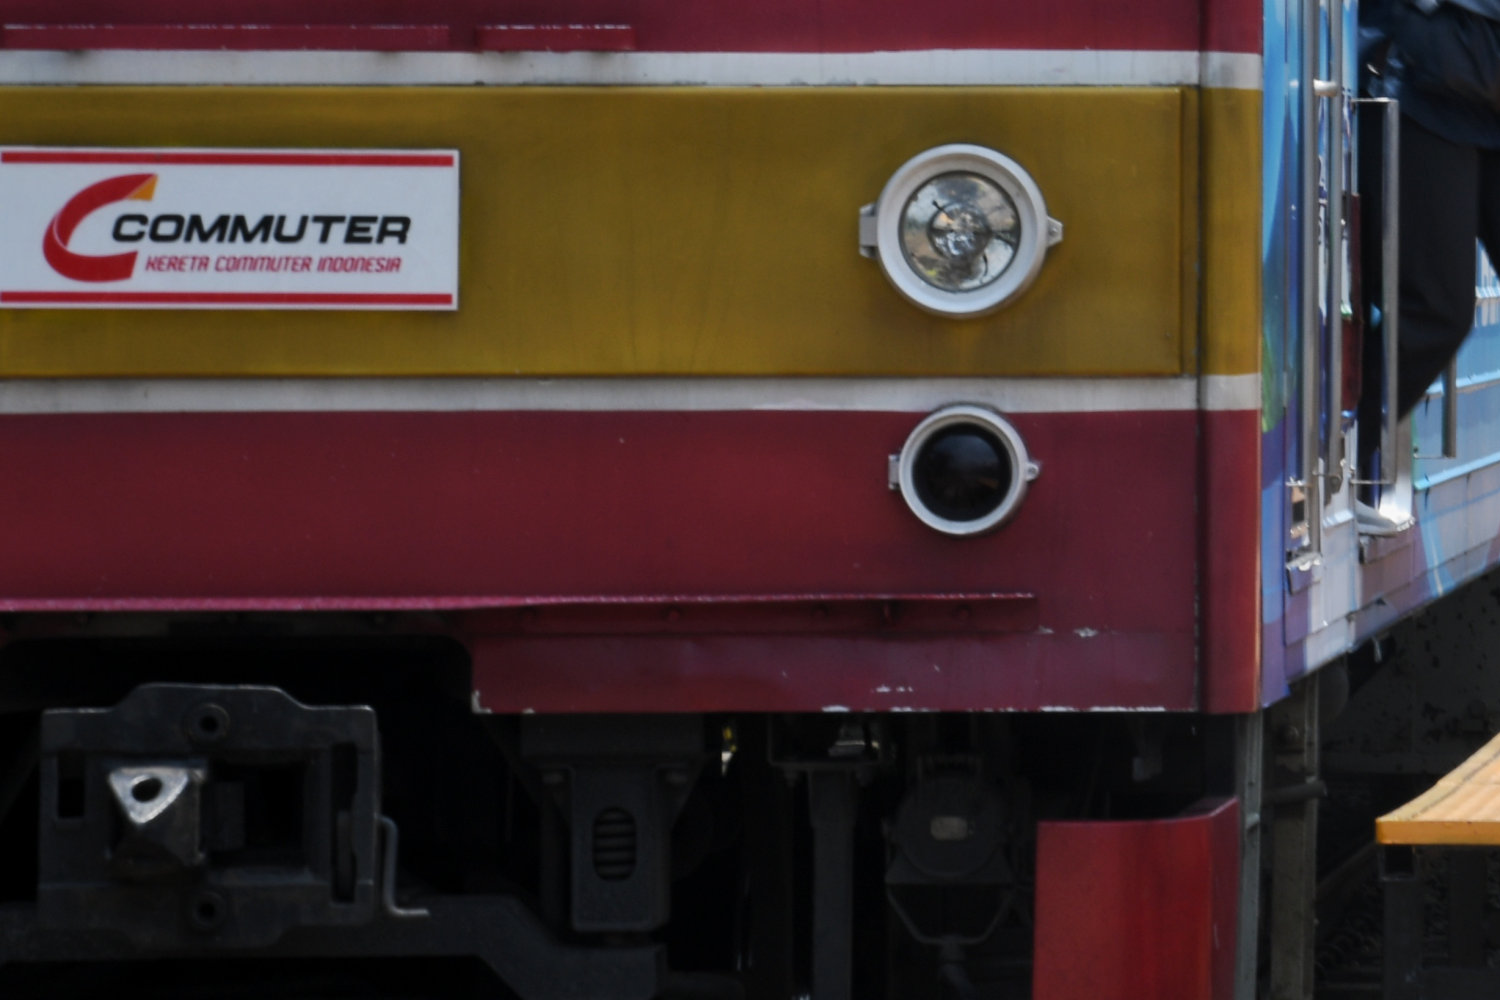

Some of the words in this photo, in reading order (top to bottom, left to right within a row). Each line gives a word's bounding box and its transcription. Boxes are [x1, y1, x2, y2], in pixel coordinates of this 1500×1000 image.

[111, 213, 412, 245] COMMUTER
[145, 255, 209, 272] KERETA
[214, 256, 312, 273] COMMUTER
[316, 257, 403, 273] INDONESIA
